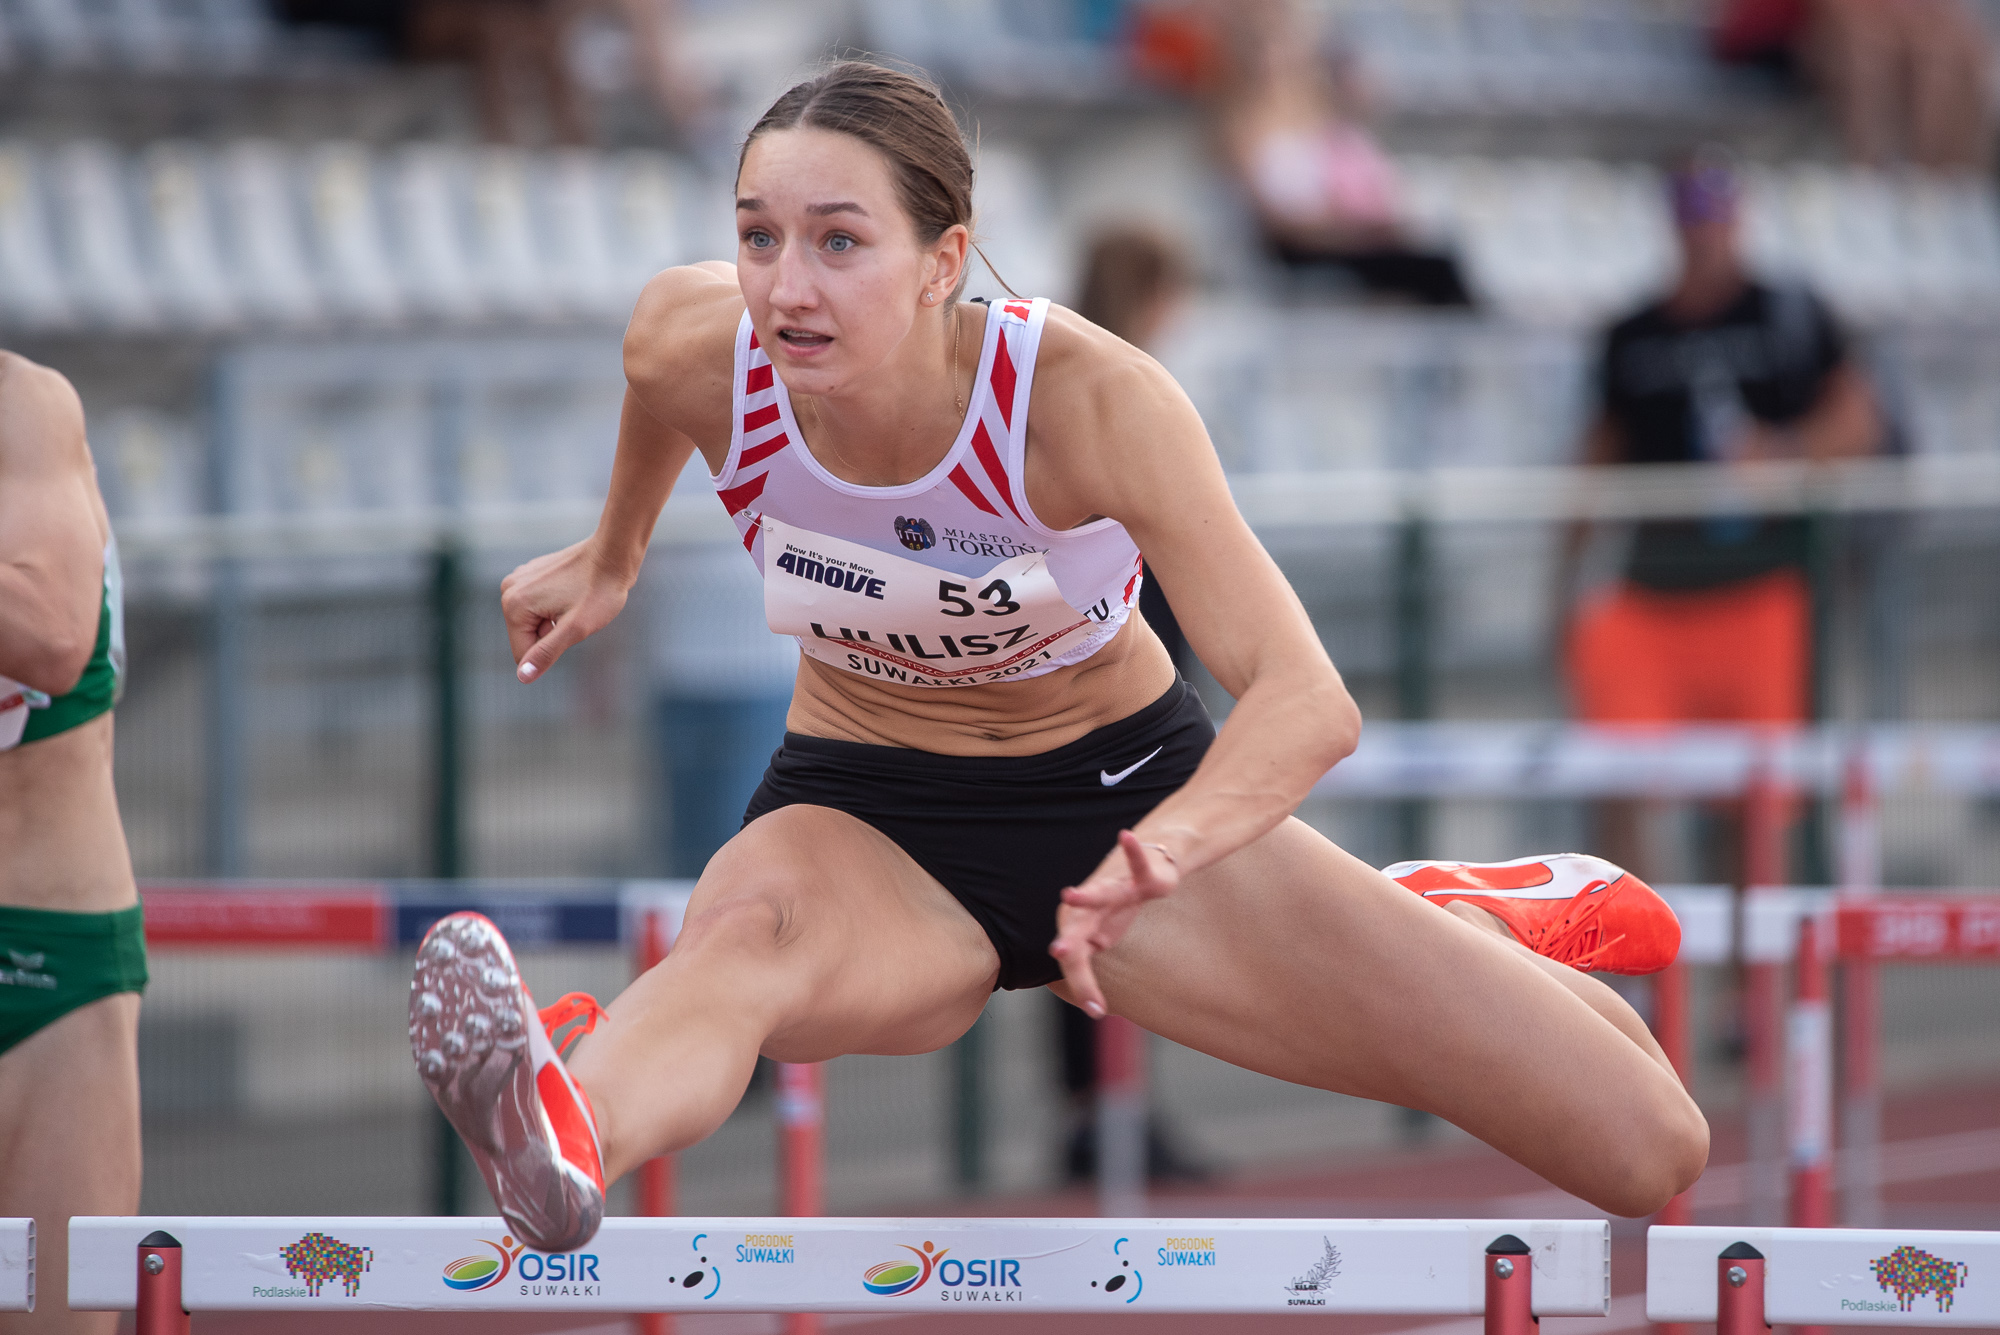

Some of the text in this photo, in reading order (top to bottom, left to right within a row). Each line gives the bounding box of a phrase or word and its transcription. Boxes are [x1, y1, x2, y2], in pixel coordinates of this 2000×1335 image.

[943, 527, 1012, 544] MIASTO
[942, 536, 1038, 558] TORUŃ
[785, 543, 874, 575] Now It's your Move
[776, 552, 886, 600] 4MOVE
[938, 579, 1022, 618] 53
[847, 650, 1052, 686] SUWAŁKI 2021
[878, 651, 990, 677] MISTRZOSTWA
[993, 640, 1046, 669] POLSKI
[745, 1234, 794, 1248] POGODNE
[1166, 1237, 1215, 1250] POGODNE
[736, 1244, 794, 1263] SUWAŁKI
[1157, 1247, 1215, 1266] SUWAŁKI
[518, 1253, 600, 1281] OSIR
[939, 1259, 1022, 1287] OSIR
[253, 1286, 306, 1298] Podlaskie
[520, 1285, 601, 1296] SUWAŁKI
[941, 1291, 1022, 1301] SUWAŁKI
[1841, 1299, 1897, 1312] Podlaskie
